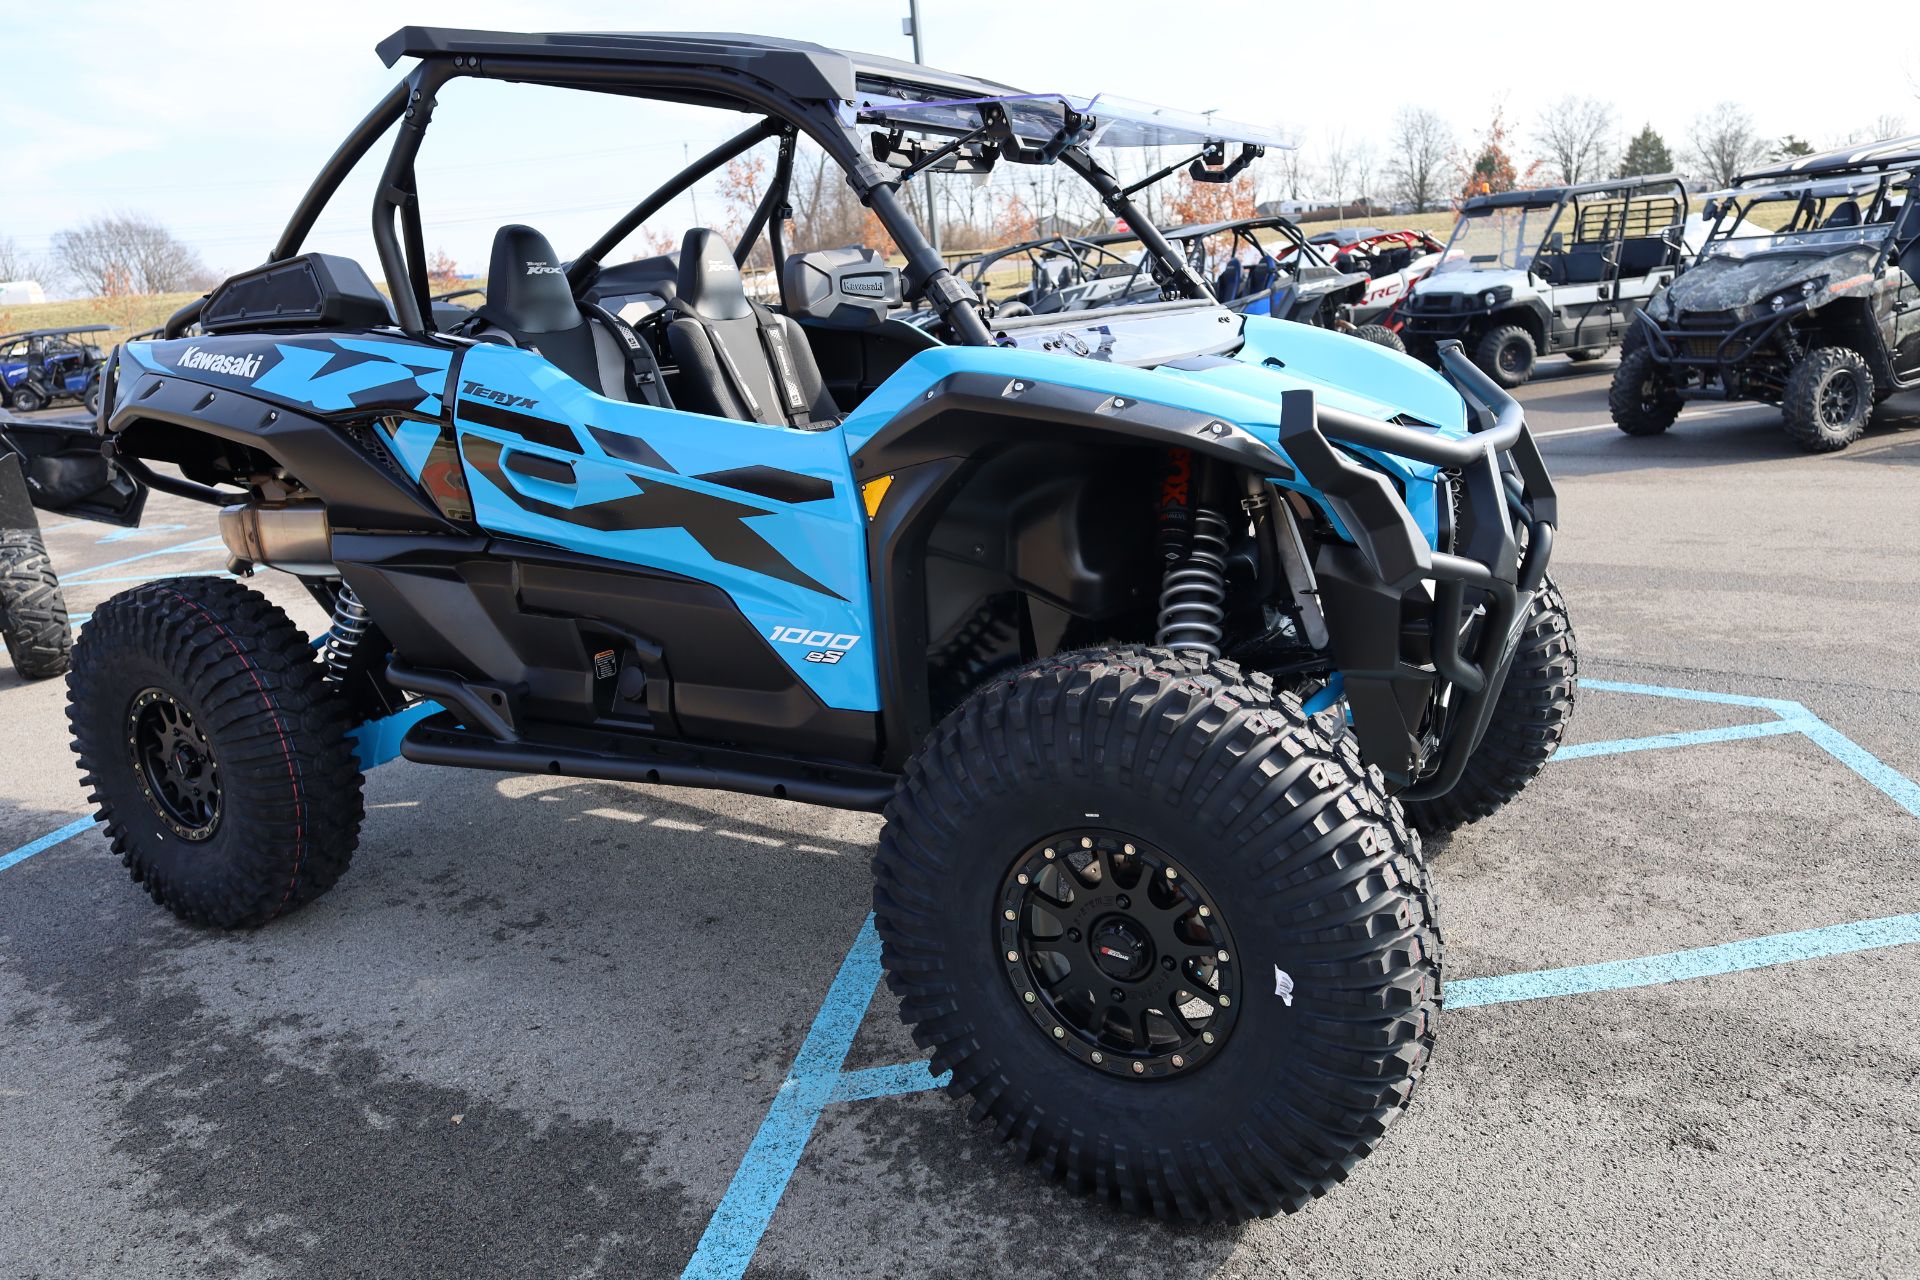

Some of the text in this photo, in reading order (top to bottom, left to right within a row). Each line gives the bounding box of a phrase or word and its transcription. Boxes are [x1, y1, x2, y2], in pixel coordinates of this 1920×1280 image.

[843, 281, 883, 291] Kawasaki
[177, 346, 264, 379] Kawasaki
[769, 625, 861, 650] 1000
